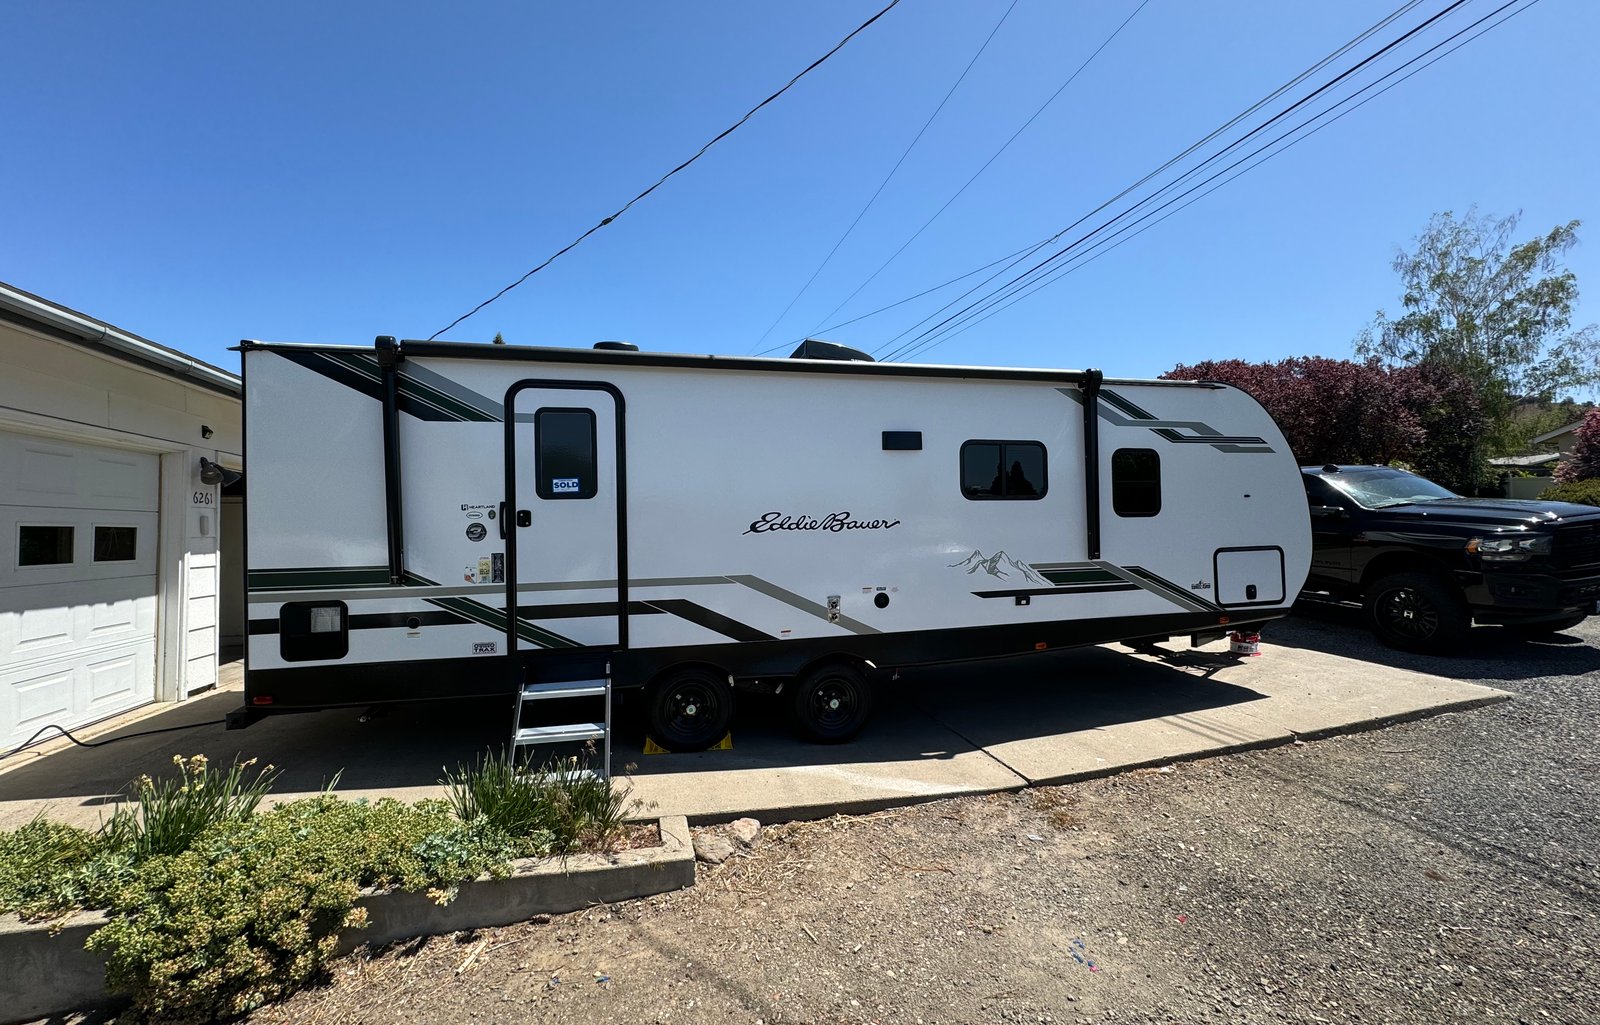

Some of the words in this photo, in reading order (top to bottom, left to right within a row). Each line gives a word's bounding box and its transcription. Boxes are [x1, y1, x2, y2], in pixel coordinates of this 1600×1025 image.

[554, 481, 578, 489] SOLD
[193, 490, 213, 505] 6261
[742, 511, 819, 535] Eddie
[821, 511, 901, 533] Bauer
